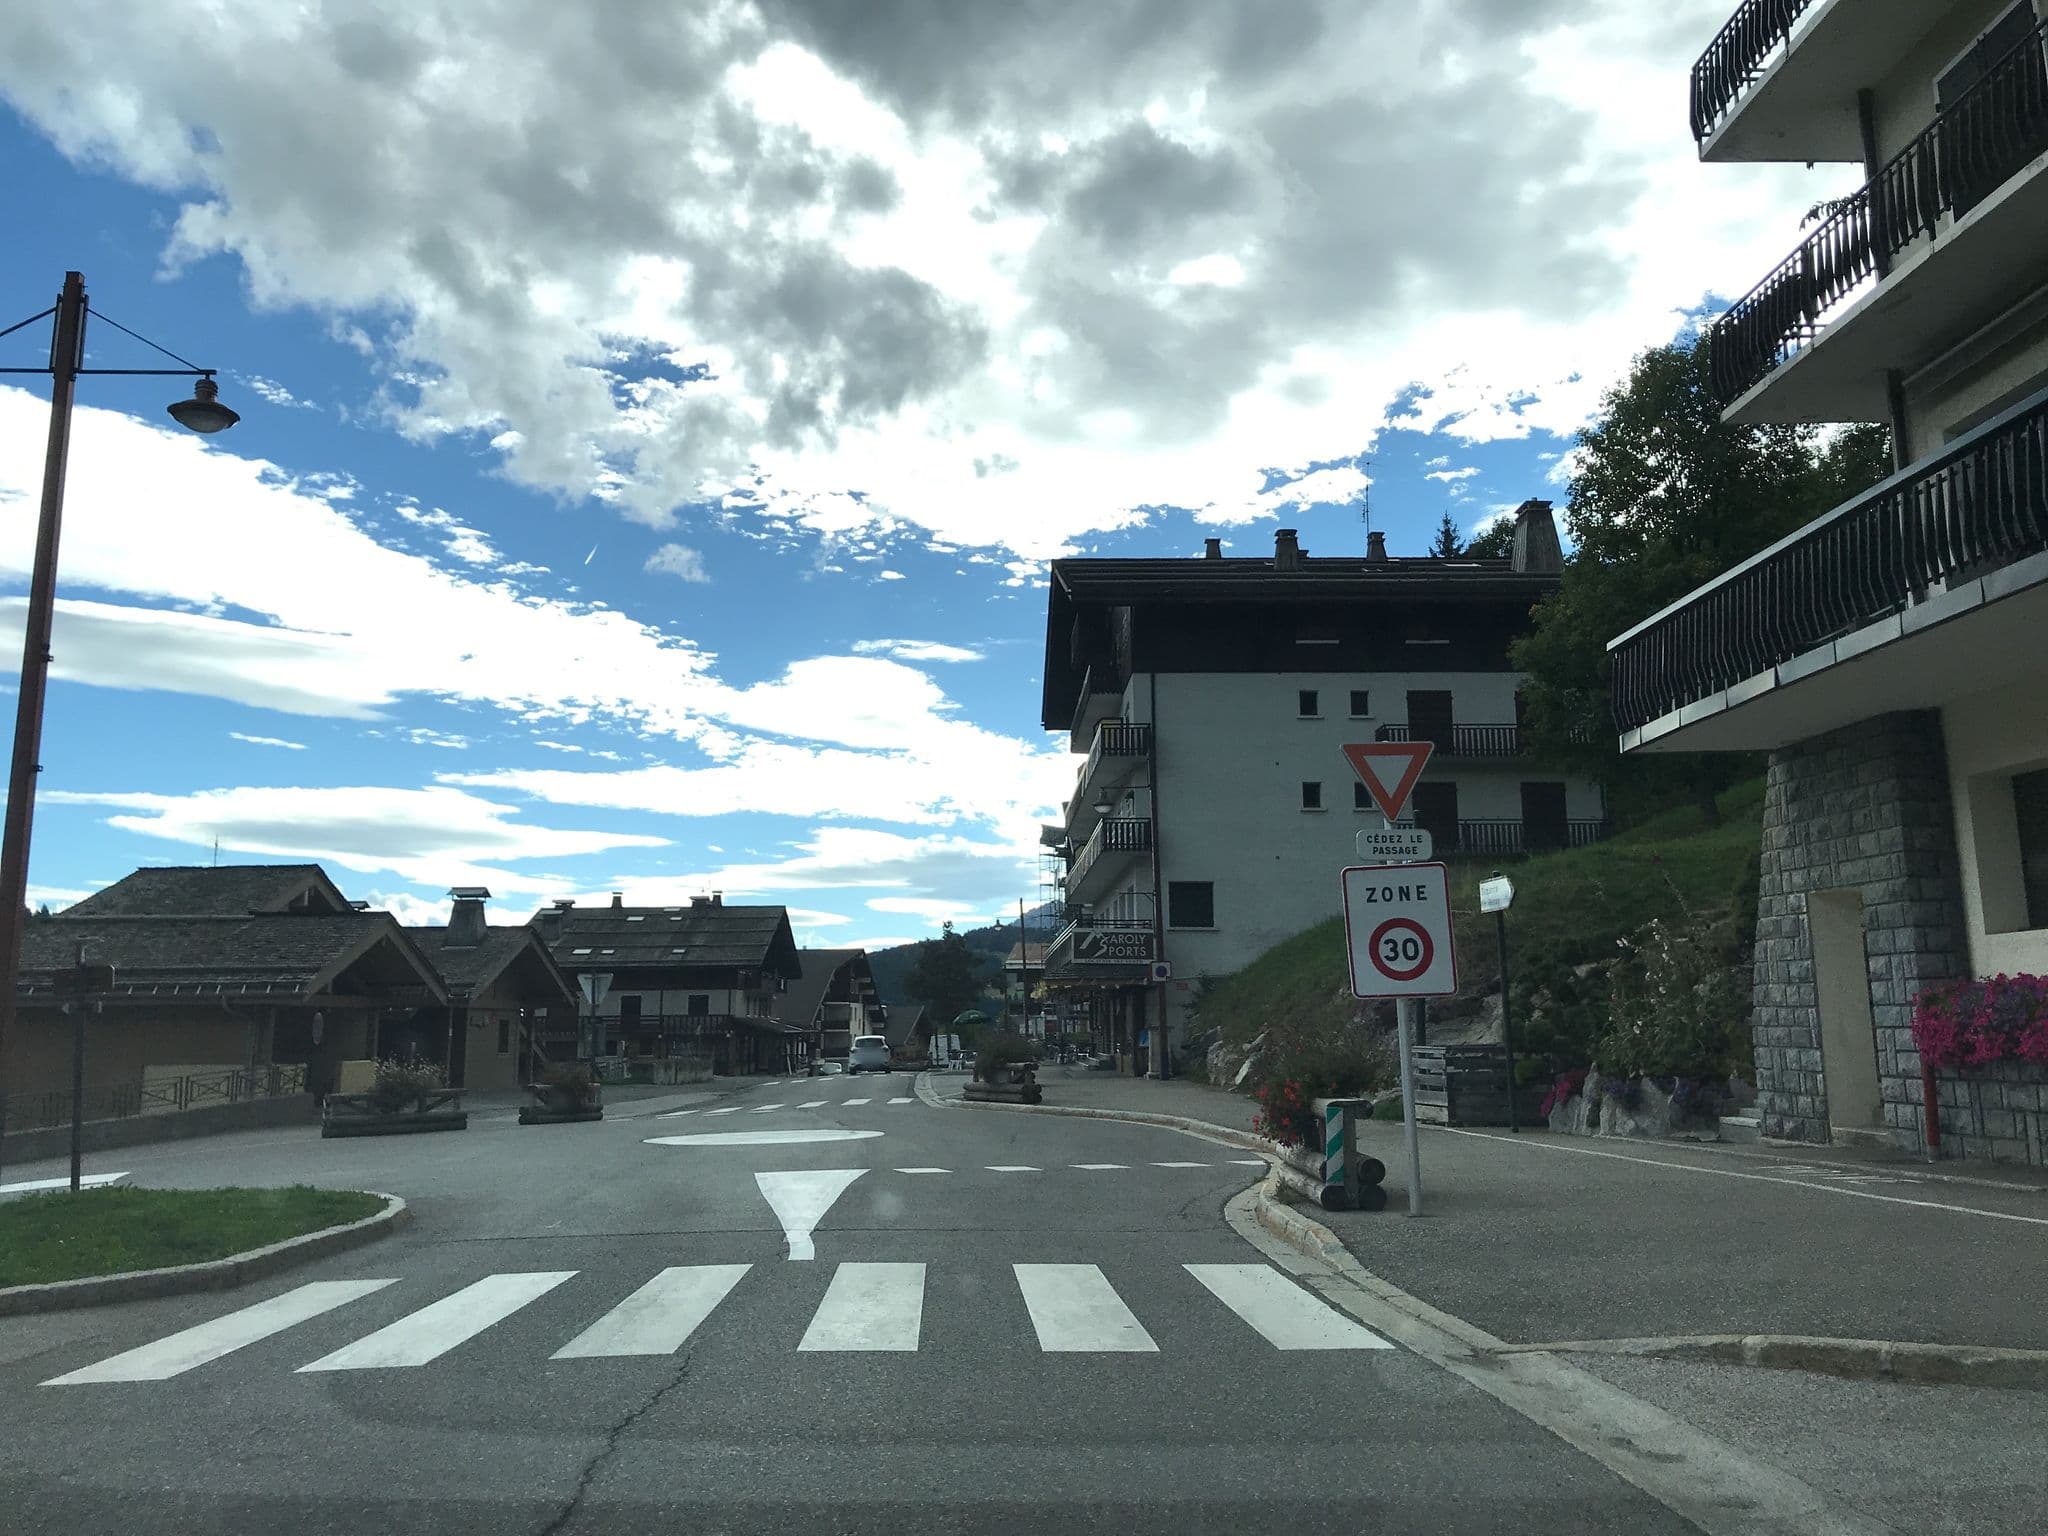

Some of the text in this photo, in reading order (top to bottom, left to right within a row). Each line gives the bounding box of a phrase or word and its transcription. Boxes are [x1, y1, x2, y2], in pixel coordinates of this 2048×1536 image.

[1366, 833, 1423, 843] CÉDEZ LE
[1372, 846, 1418, 855] PASSAGE
[1365, 885, 1428, 903] ZONE
[1383, 937, 1420, 962] 30
